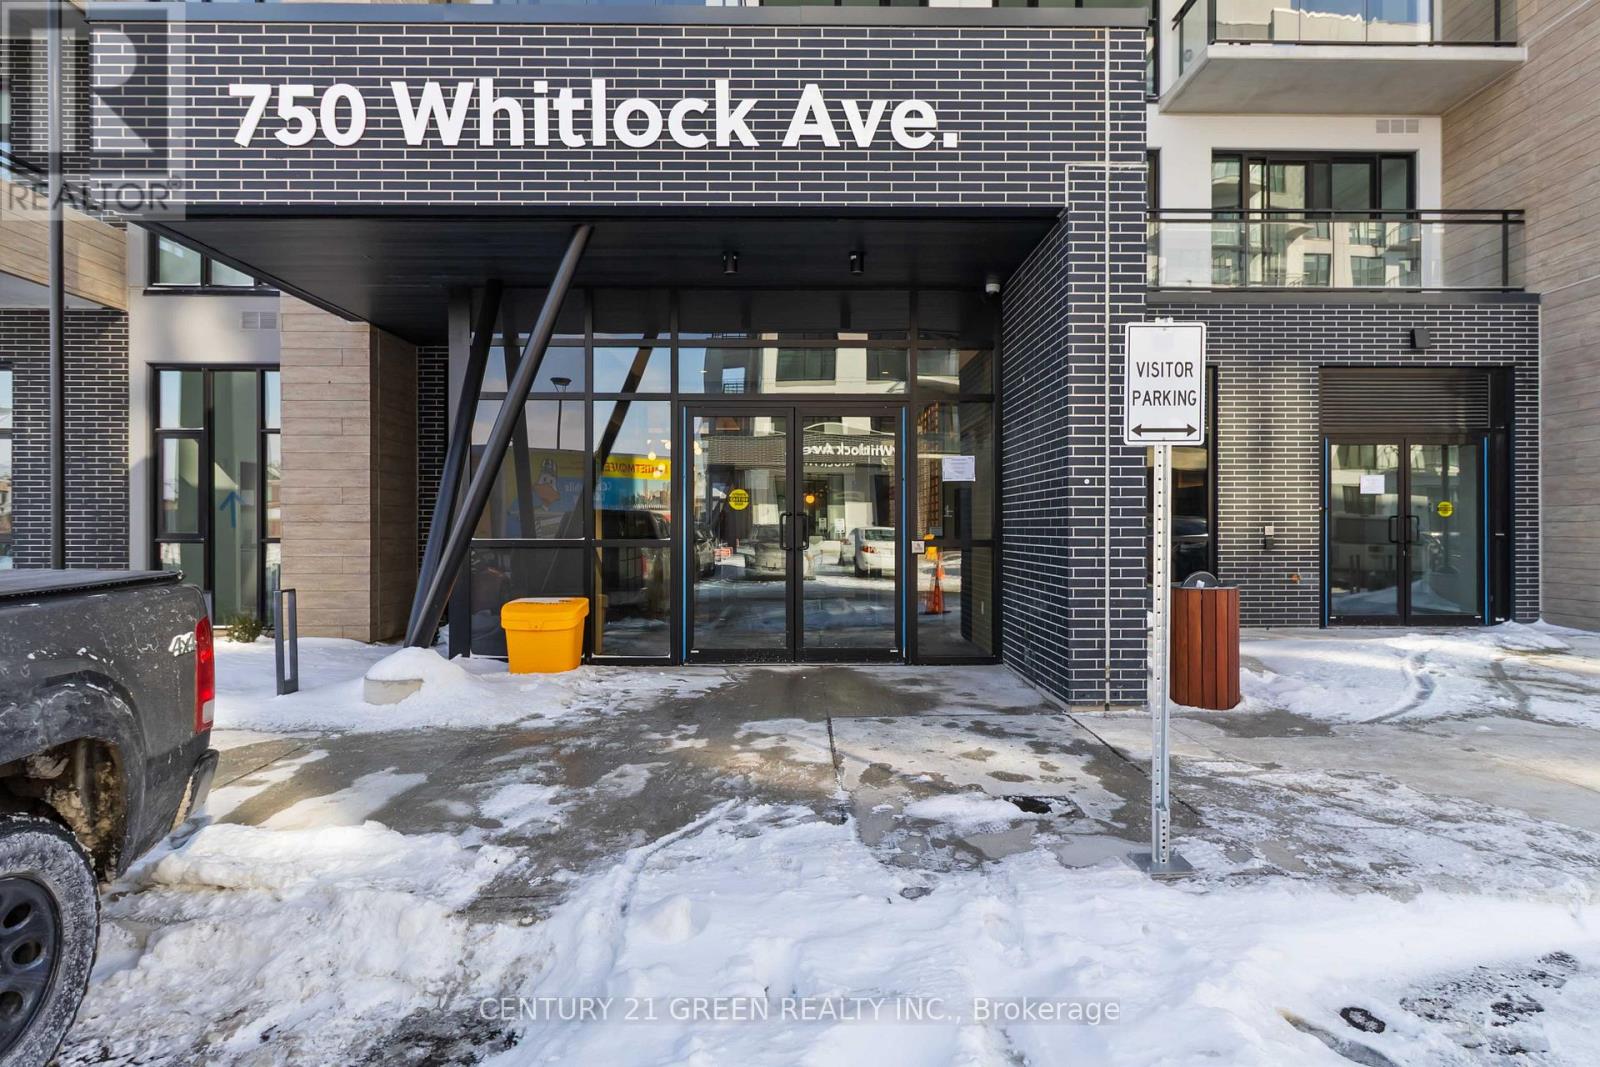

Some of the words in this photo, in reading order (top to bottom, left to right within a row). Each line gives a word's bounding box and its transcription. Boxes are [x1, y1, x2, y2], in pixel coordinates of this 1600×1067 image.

[229, 83, 366, 147] 750
[390, 78, 760, 148] Whitlock
[781, 83, 957, 149] Ave.
[1136, 361, 1194, 378] VISITOR
[1132, 390, 1197, 407] PARKING
